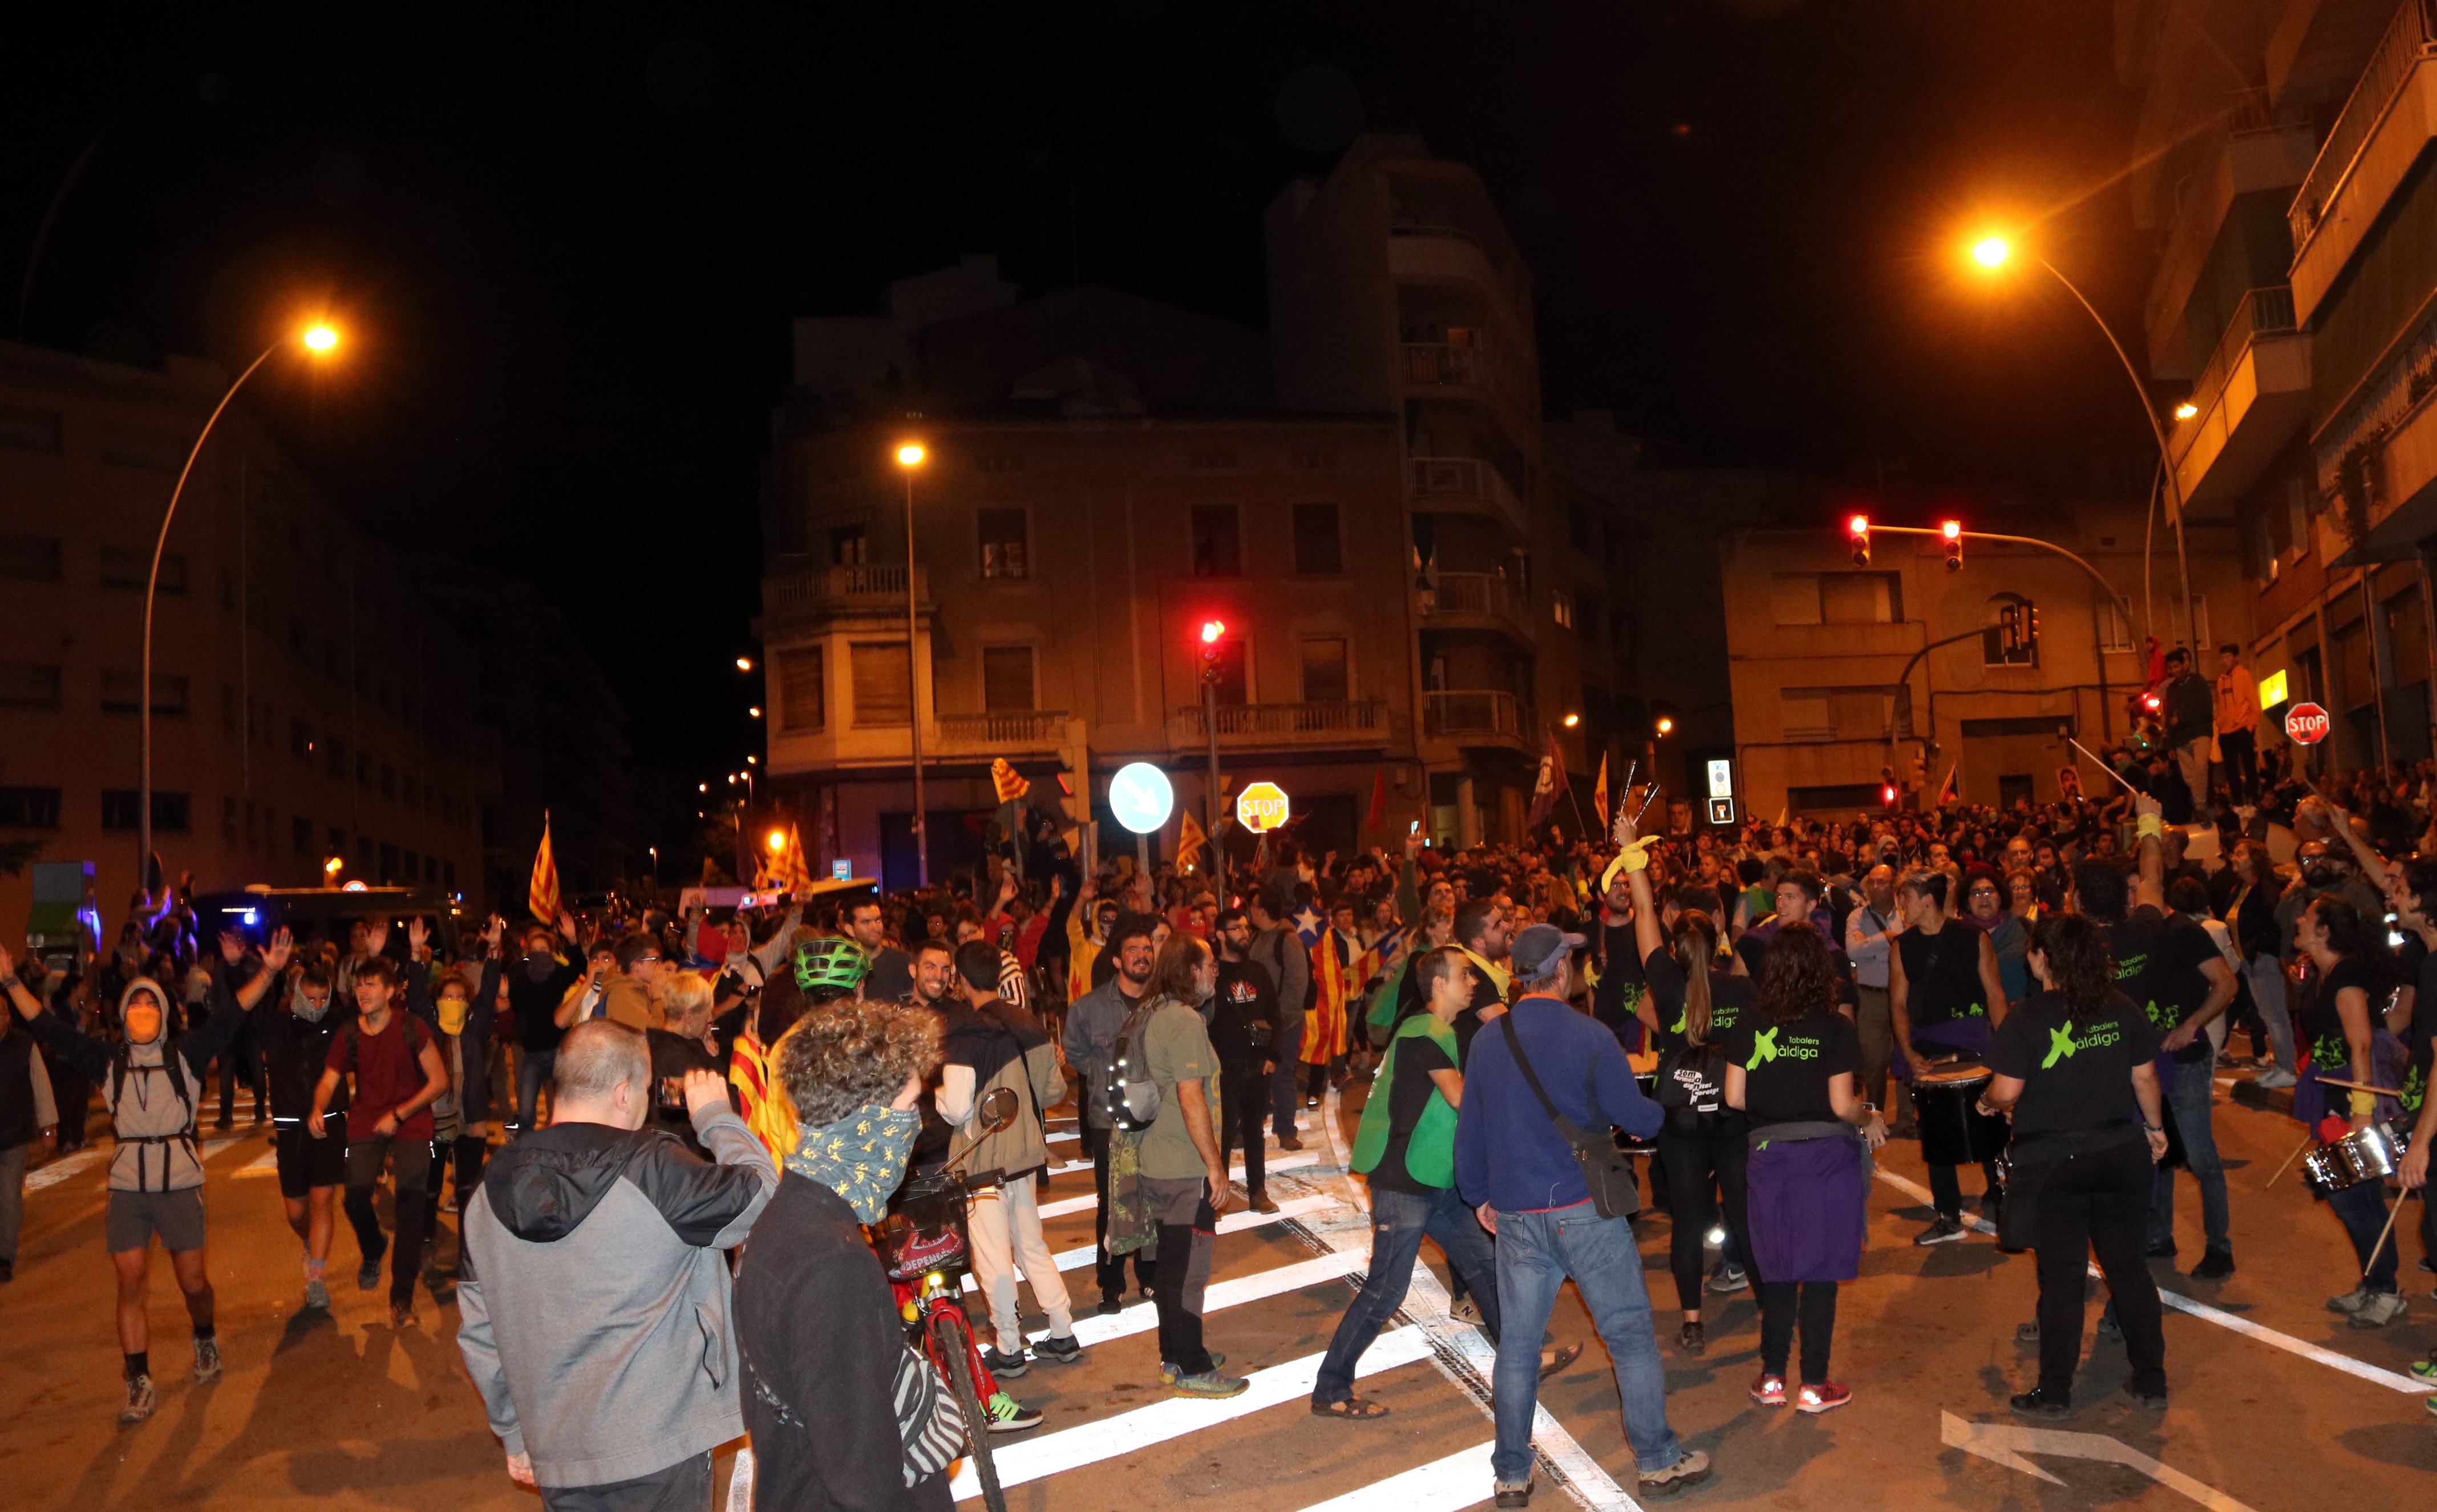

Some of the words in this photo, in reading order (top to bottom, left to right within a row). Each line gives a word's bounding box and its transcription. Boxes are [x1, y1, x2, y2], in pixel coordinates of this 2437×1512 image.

[2289, 715, 2326, 732] STOP
[1242, 799, 1284, 817] STOP
[1788, 1036, 1820, 1045] Tabalers
